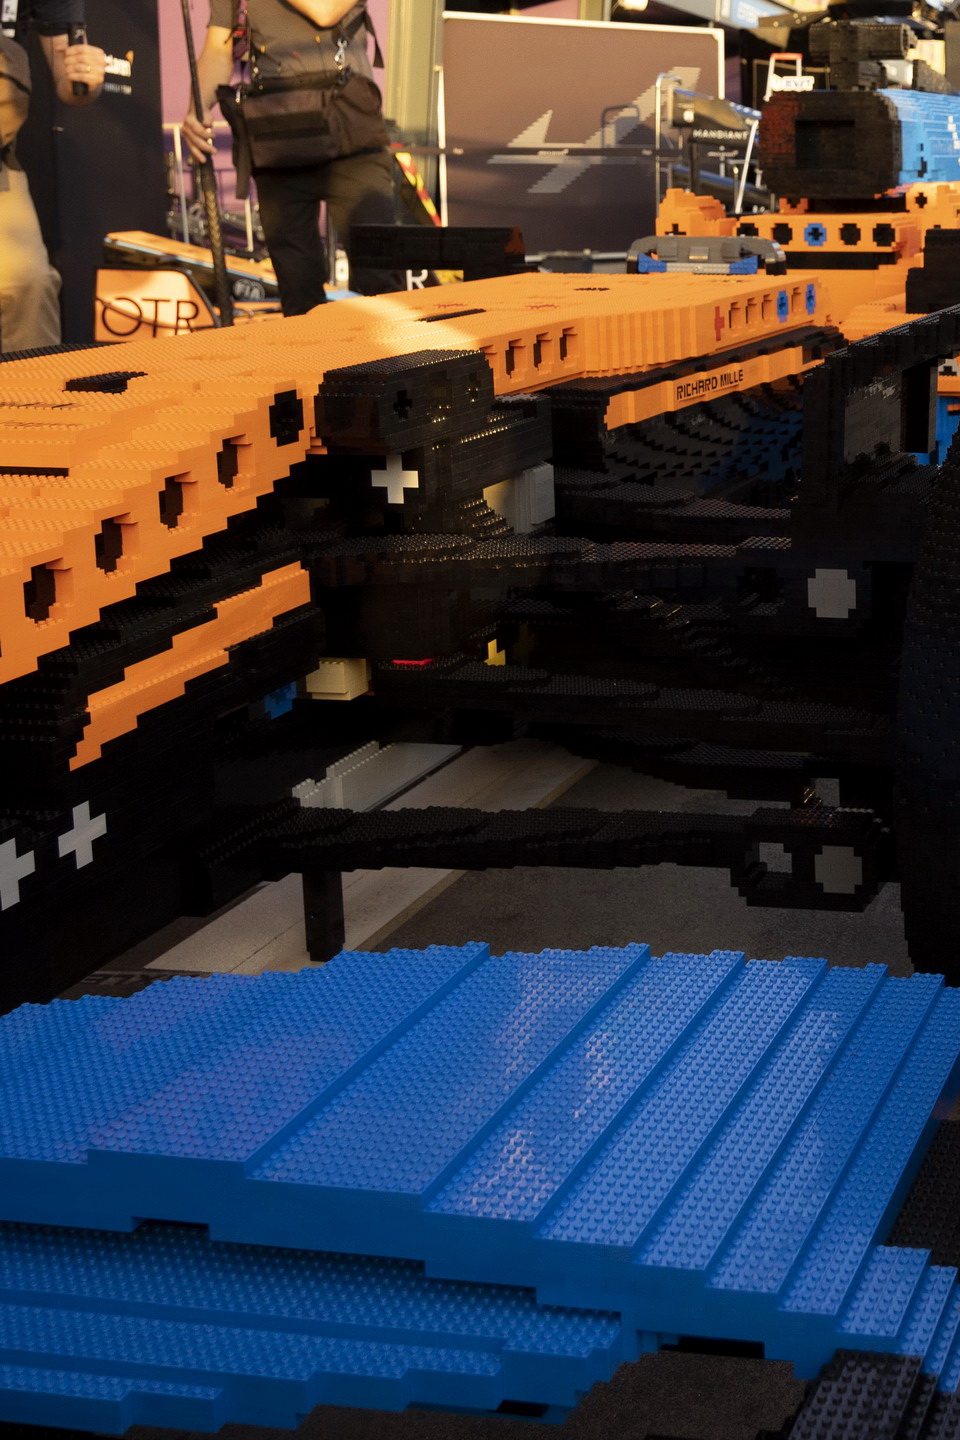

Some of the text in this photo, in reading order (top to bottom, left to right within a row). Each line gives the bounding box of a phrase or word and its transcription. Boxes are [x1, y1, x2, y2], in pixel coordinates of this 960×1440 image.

[693, 129, 749, 141] MANDIANT
[677, 369, 743, 400] RICHARD MILLE
